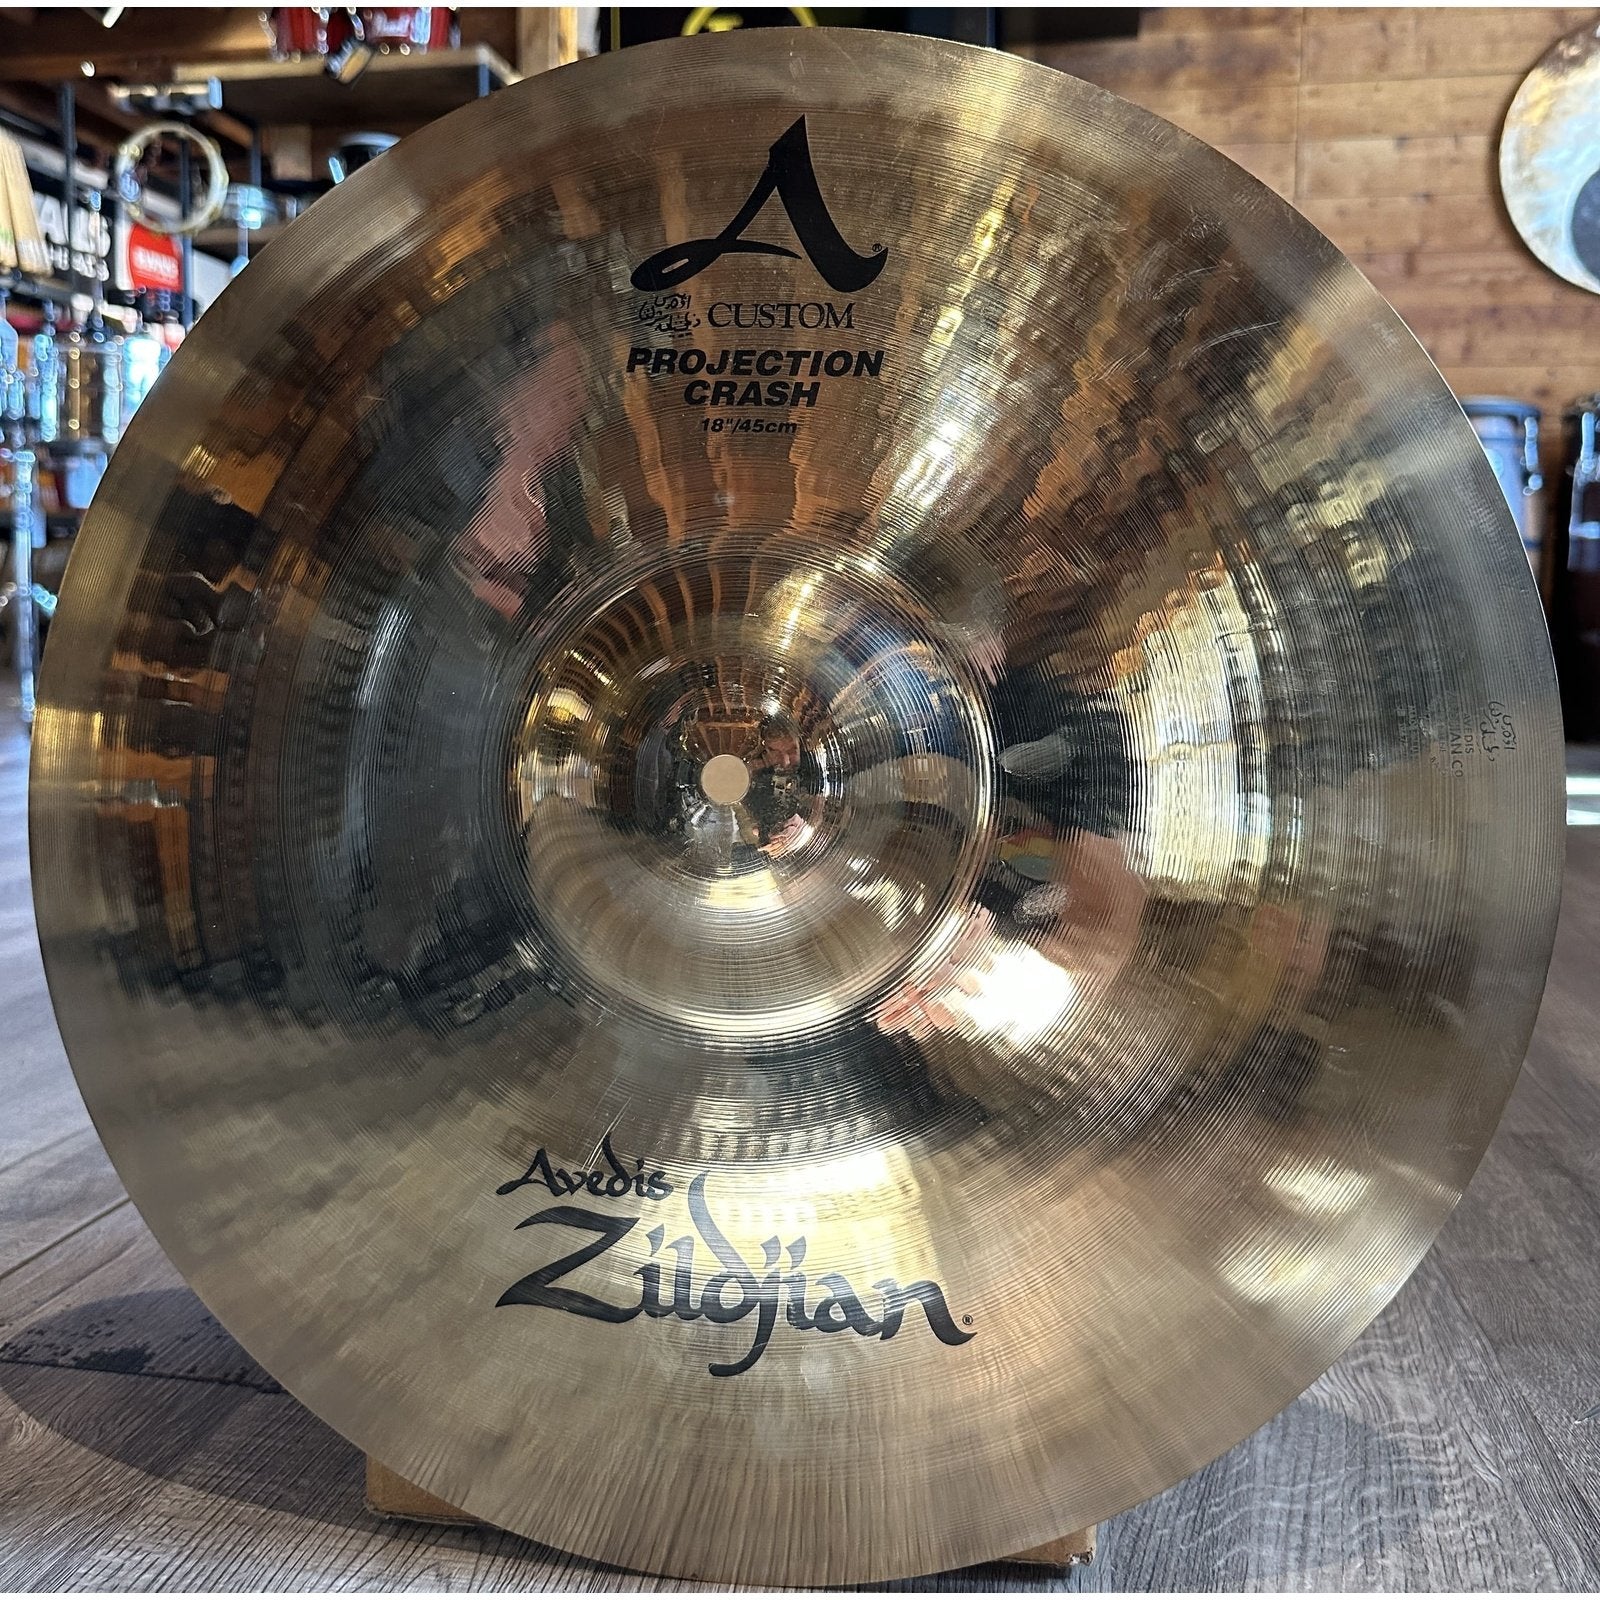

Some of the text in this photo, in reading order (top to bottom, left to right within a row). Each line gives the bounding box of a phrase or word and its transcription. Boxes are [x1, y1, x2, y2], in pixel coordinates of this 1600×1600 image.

[630, 113, 888, 293] A
[707, 301, 856, 330] CUSTOM
[626, 347, 885, 378] PROJECTION
[684, 381, 820, 408] CRASH
[701, 417, 797, 434] 18"/45cm
[1463, 713, 1474, 754] AVEDIS
[496, 1132, 675, 1200] Avedis
[495, 1170, 977, 1377] Zildjian
